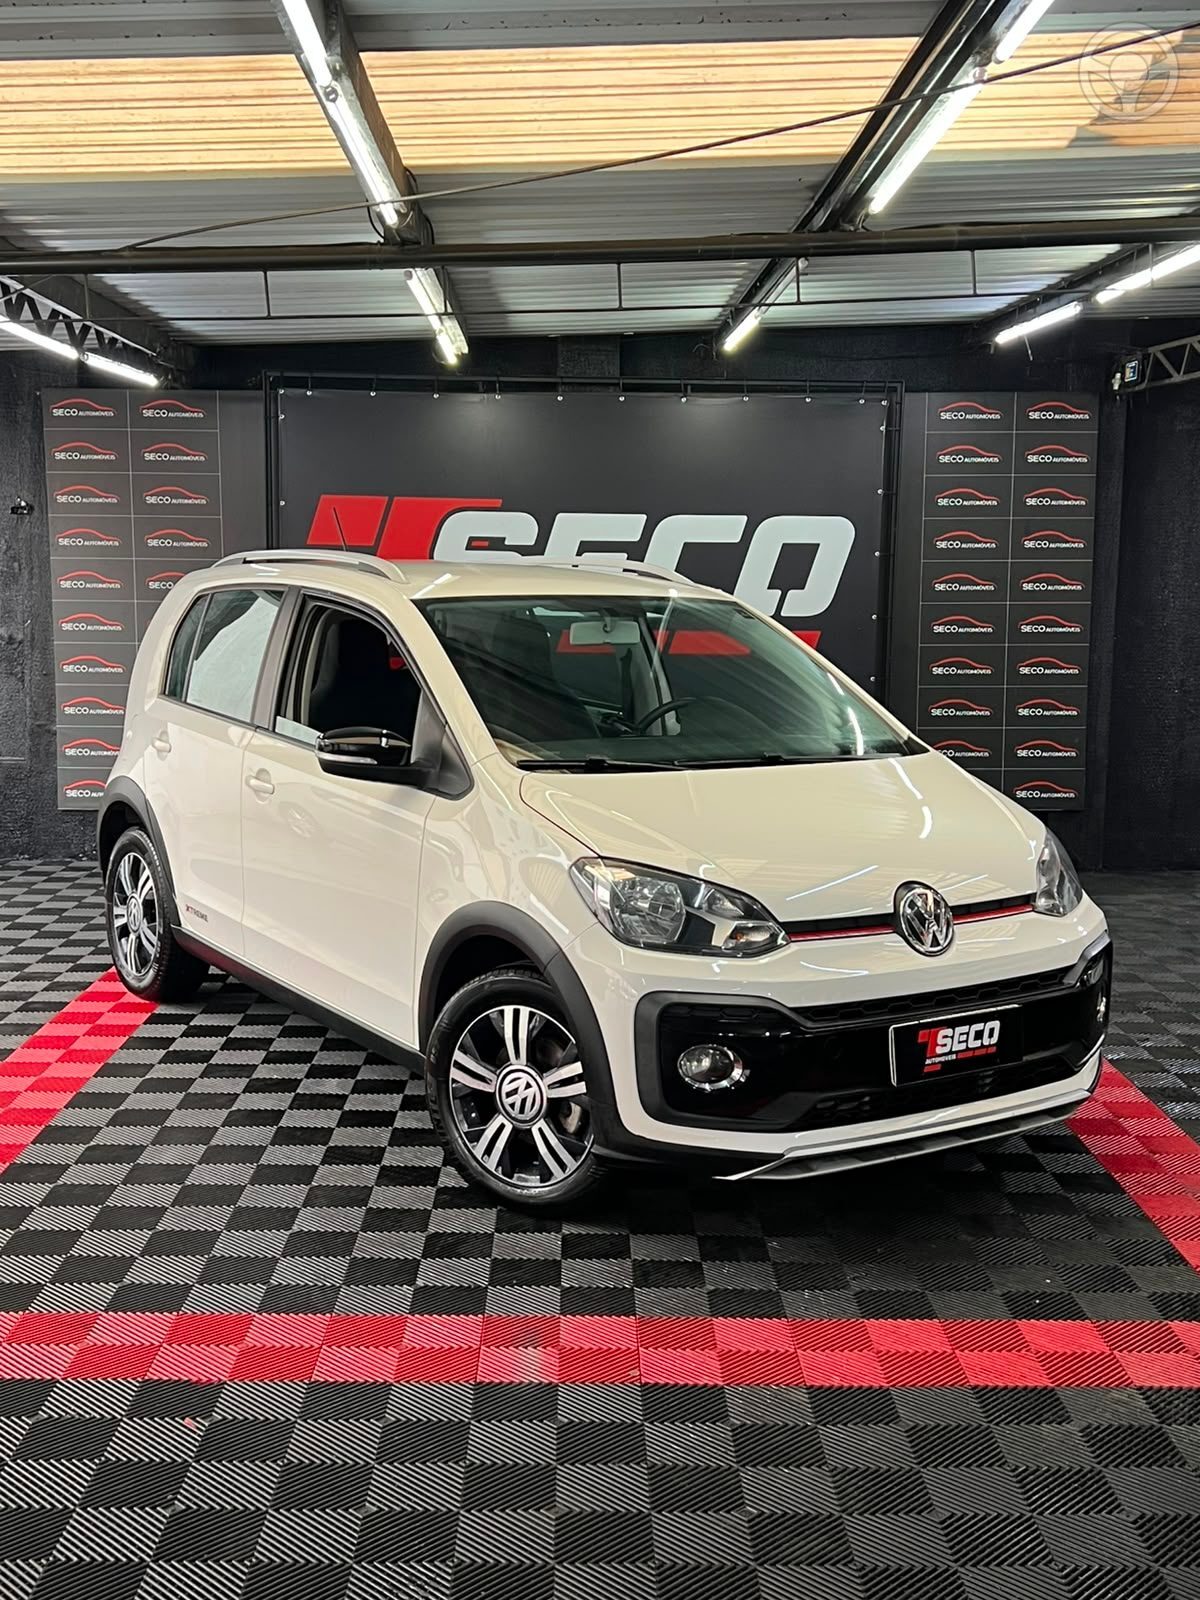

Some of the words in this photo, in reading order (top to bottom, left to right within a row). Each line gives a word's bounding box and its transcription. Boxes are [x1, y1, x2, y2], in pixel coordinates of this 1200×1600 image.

[53, 409, 78, 417] SECO
[142, 409, 167, 417] SECO
[940, 412, 965, 420] SECO
[1028, 412, 1053, 420] SECO
[55, 452, 80, 460] SECO
[144, 453, 169, 461] SECO
[939, 455, 964, 463] SECO
[1027, 455, 1052, 463] SECO
[56, 495, 81, 503] SECO
[146, 496, 171, 504] SECO
[937, 498, 962, 506] SECO
[1026, 498, 1051, 506] SECO
[58, 538, 83, 546] SECO
[147, 539, 172, 547] SECO
[936, 541, 961, 549] SECO
[1024, 540, 1049, 548] SECO
[60, 581, 85, 589] SECO
[149, 581, 174, 589] SECO
[934, 583, 959, 591] SECO
[1022, 583, 1047, 591] SECO
[61, 623, 86, 631] SECO
[933, 625, 958, 633] SECO
[1020, 625, 1045, 633] SECO
[63, 665, 88, 673] SECO
[932, 667, 957, 675] SECO
[1019, 667, 1044, 675] SECO
[64, 707, 89, 715] SECO
[931, 708, 956, 716] SECO
[1018, 708, 1043, 716] SECO
[65, 749, 90, 757] SECO
[1017, 750, 1042, 758] SECO
[66, 790, 91, 798] SECO
[1016, 790, 1041, 798] SECO
